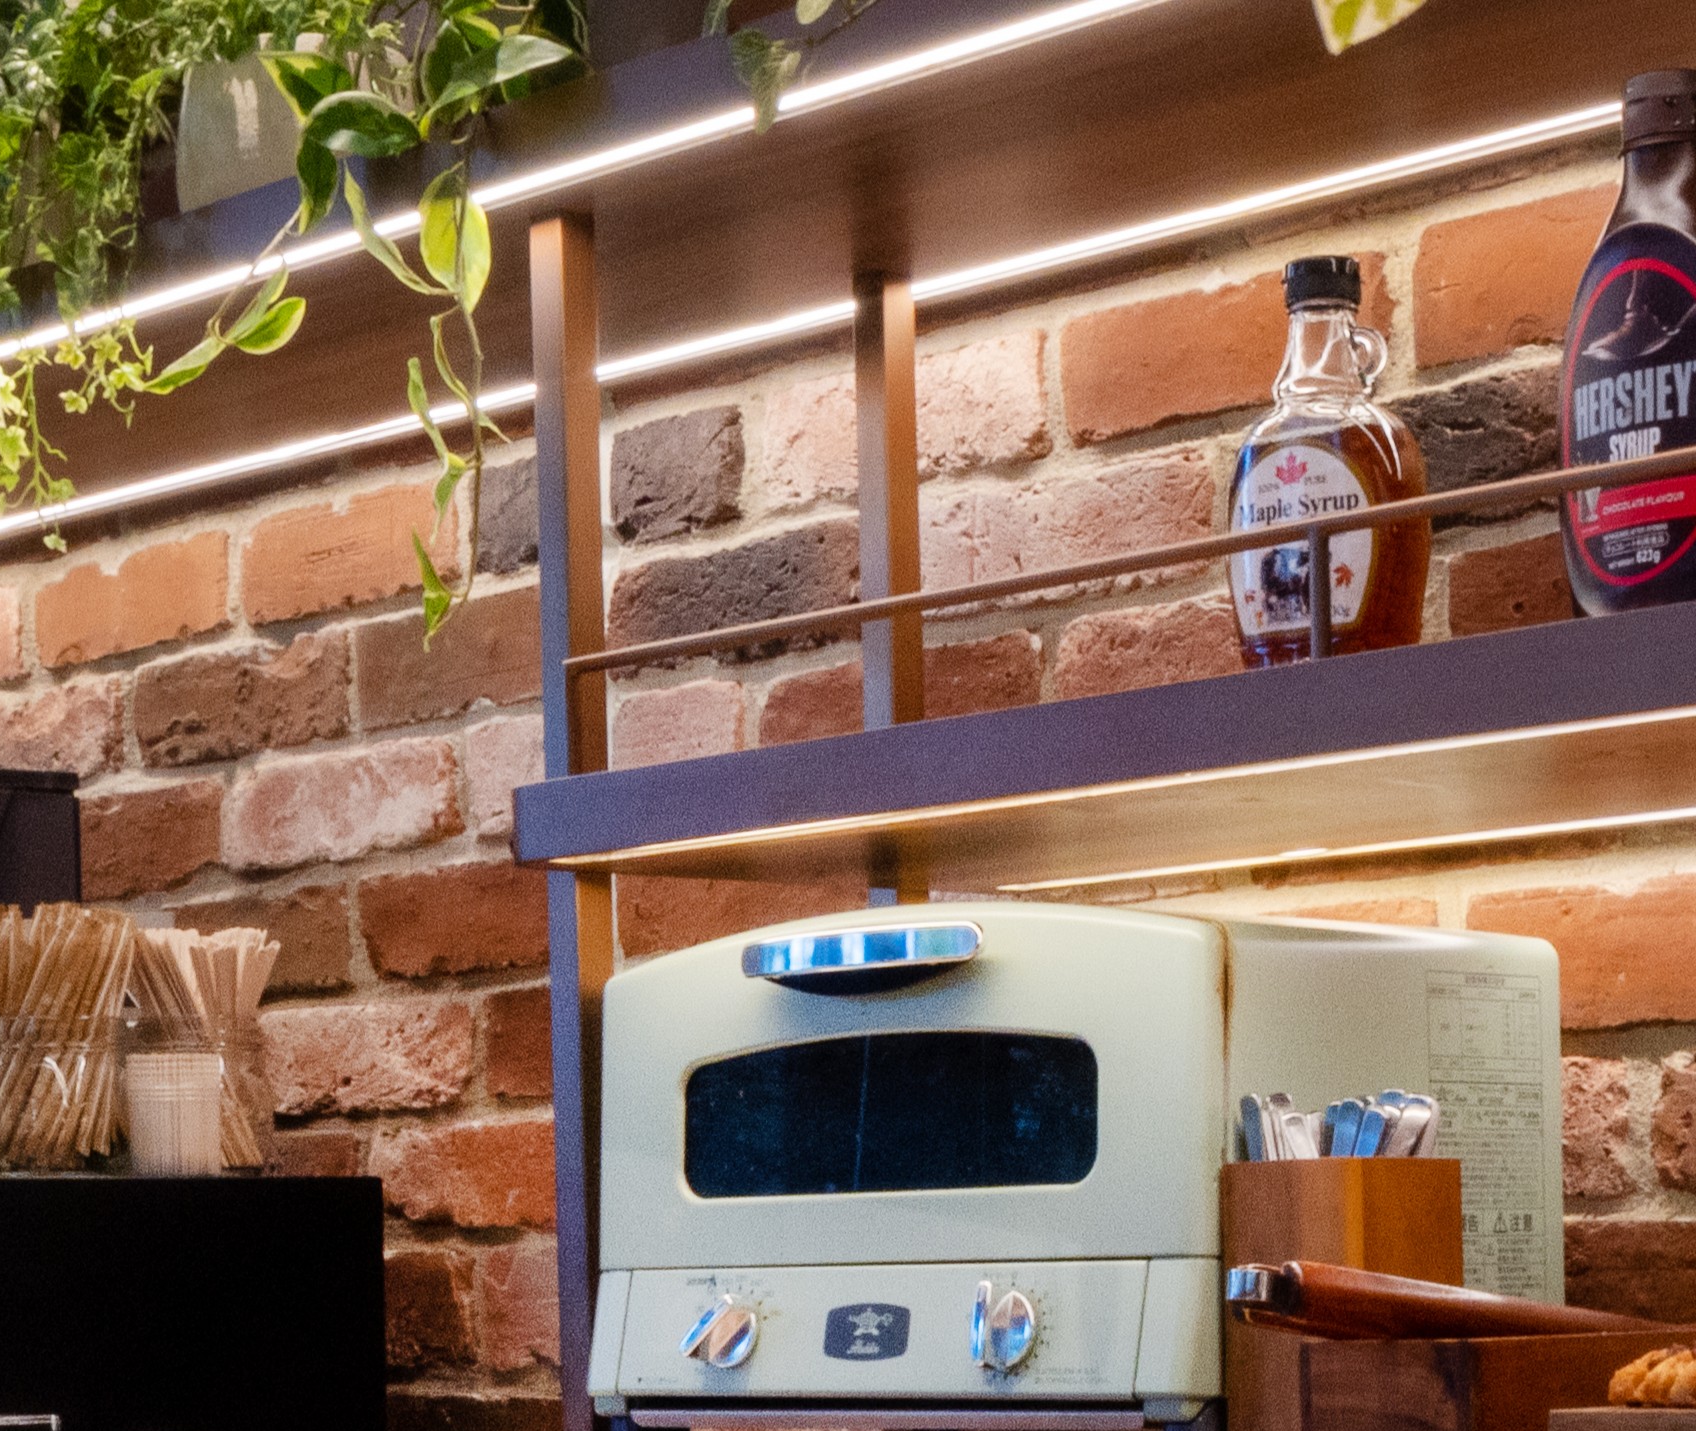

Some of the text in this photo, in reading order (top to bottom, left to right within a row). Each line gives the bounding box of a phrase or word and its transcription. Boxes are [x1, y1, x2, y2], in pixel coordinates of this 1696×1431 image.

[1608, 427, 1661, 462] SYRUP
[1239, 493, 1359, 526] Maple Syrup
